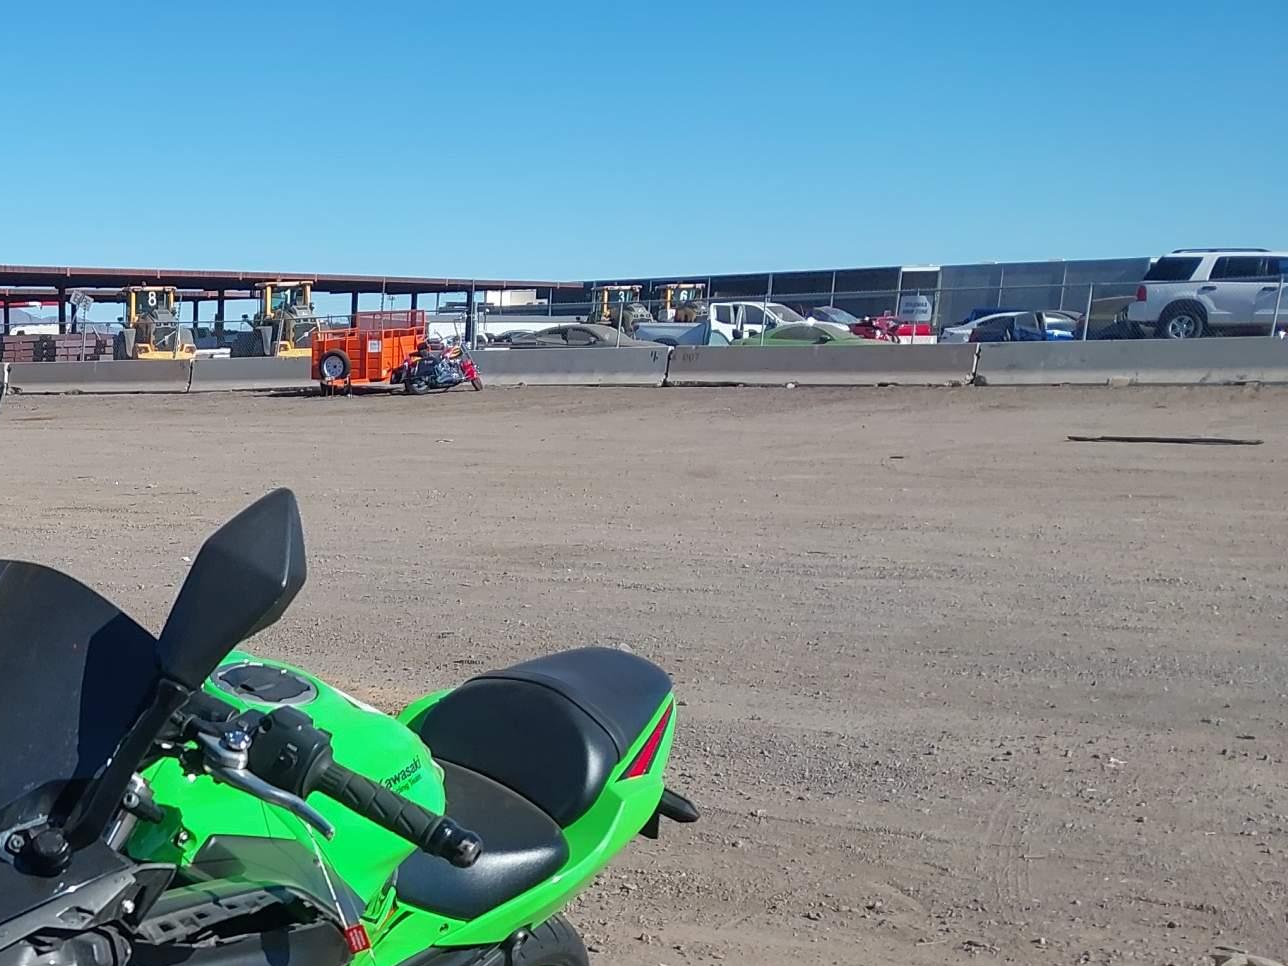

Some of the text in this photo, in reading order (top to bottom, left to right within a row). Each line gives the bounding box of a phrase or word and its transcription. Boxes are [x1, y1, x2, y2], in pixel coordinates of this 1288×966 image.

[148, 291, 157, 306] 8
[284, 289, 291, 305] 1
[618, 290, 625, 303] 3
[679, 290, 688, 301] 6
